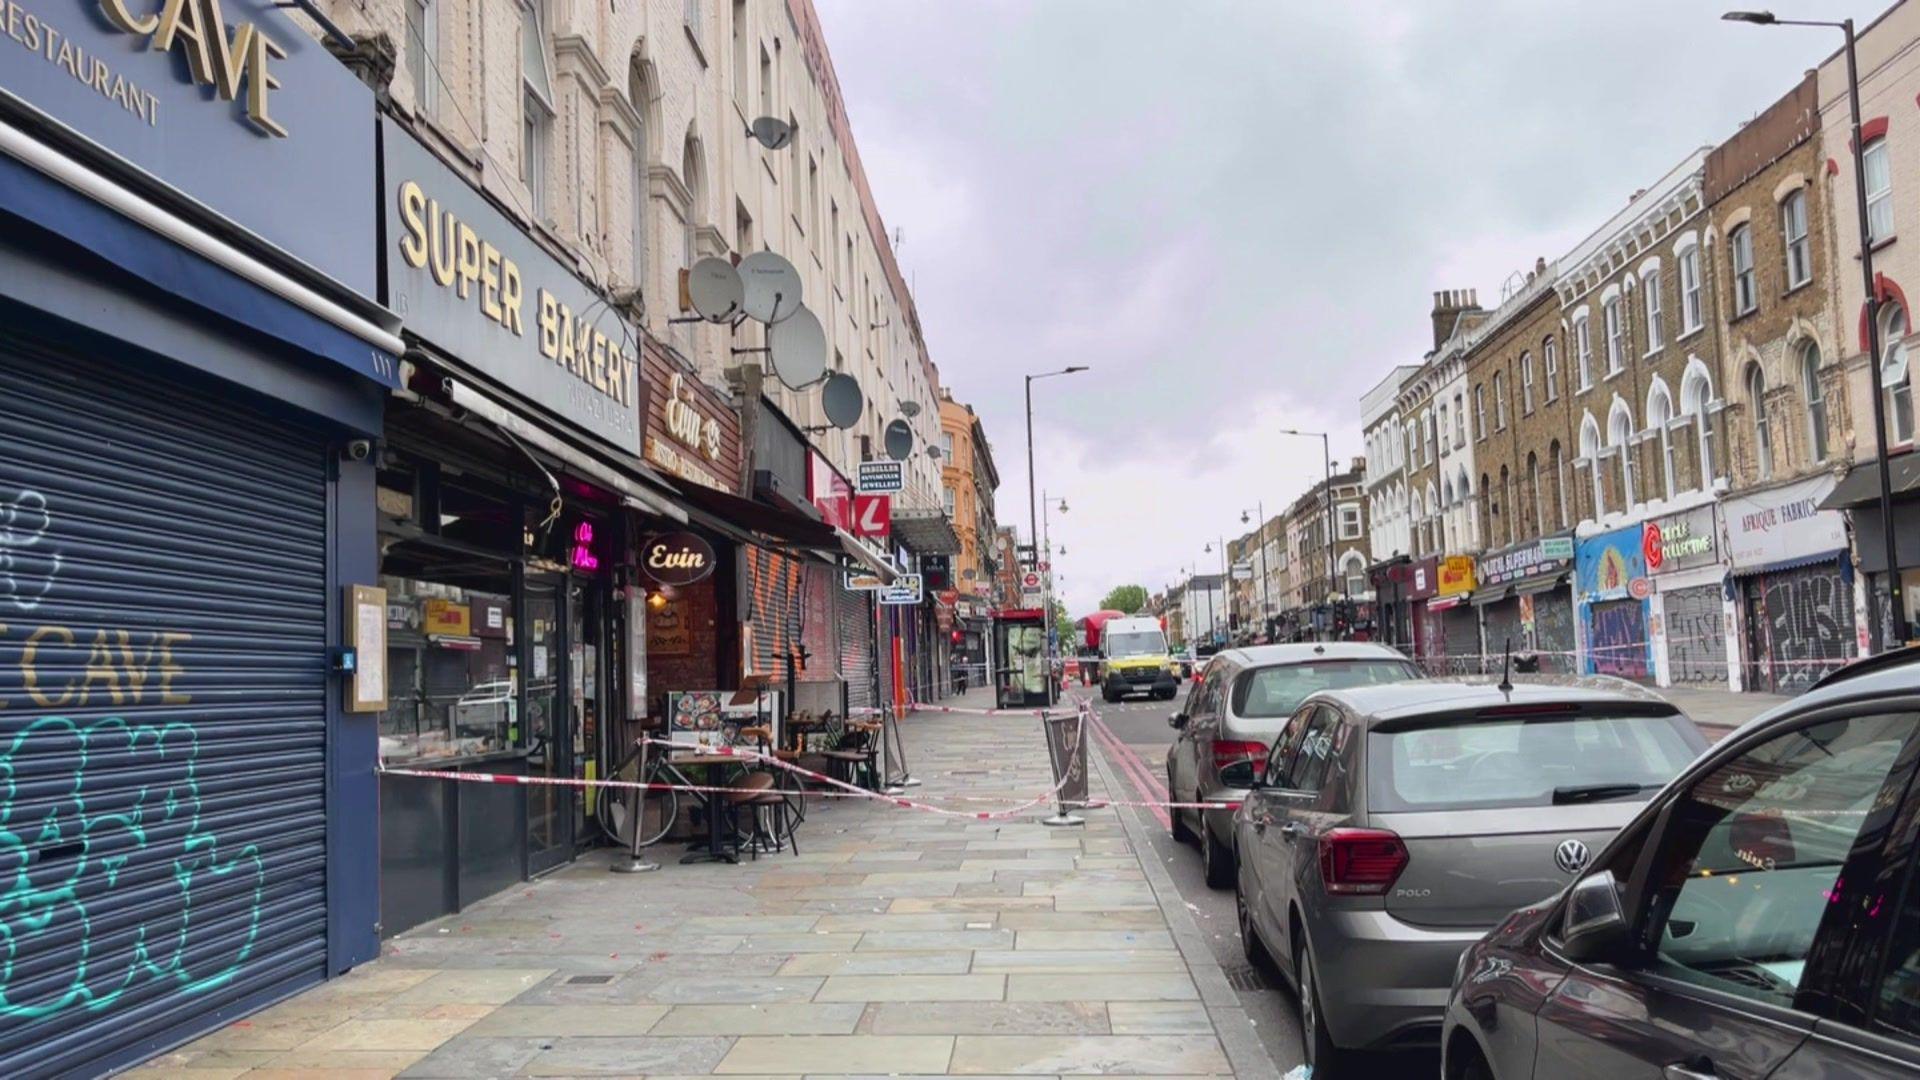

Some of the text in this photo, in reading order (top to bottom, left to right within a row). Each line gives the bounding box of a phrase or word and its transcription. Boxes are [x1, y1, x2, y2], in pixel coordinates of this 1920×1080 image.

[398, 181, 634, 408] SUPER BAKERY
[1742, 497, 1819, 532] AFRIQUE FABRICS
[648, 544, 705, 569] Evin
[20, 626, 192, 707] CAVE
[1396, 888, 1431, 898] POLO
